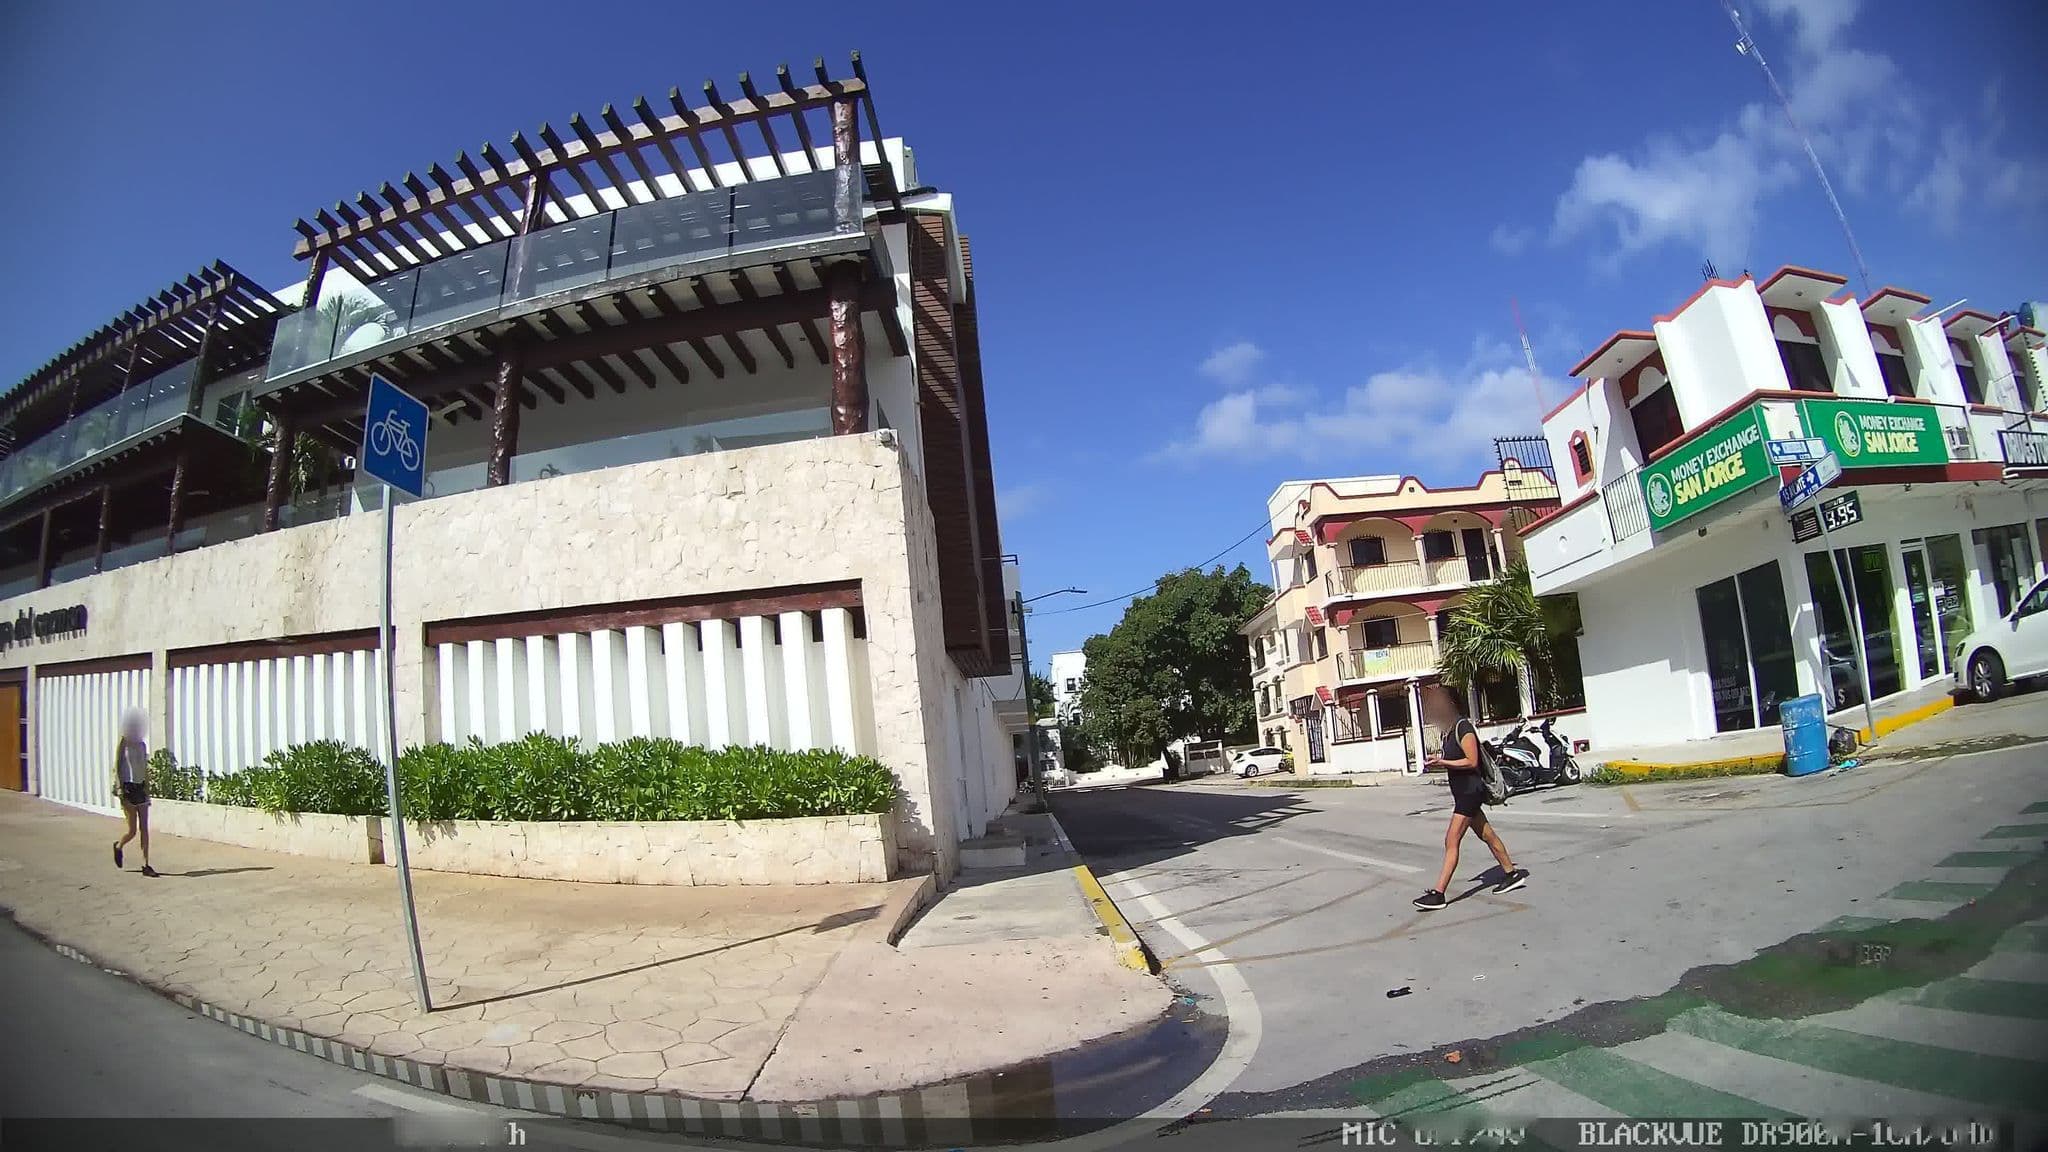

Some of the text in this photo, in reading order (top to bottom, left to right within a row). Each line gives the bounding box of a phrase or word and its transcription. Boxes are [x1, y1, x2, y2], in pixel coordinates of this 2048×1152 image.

[1859, 415, 1926, 431] MONEY EXCHANGE
[1671, 424, 1760, 484] MONEY EXCHANGE
[1864, 432, 1920, 453] SAN JORGE
[1674, 451, 1746, 505] SAN JORGE
